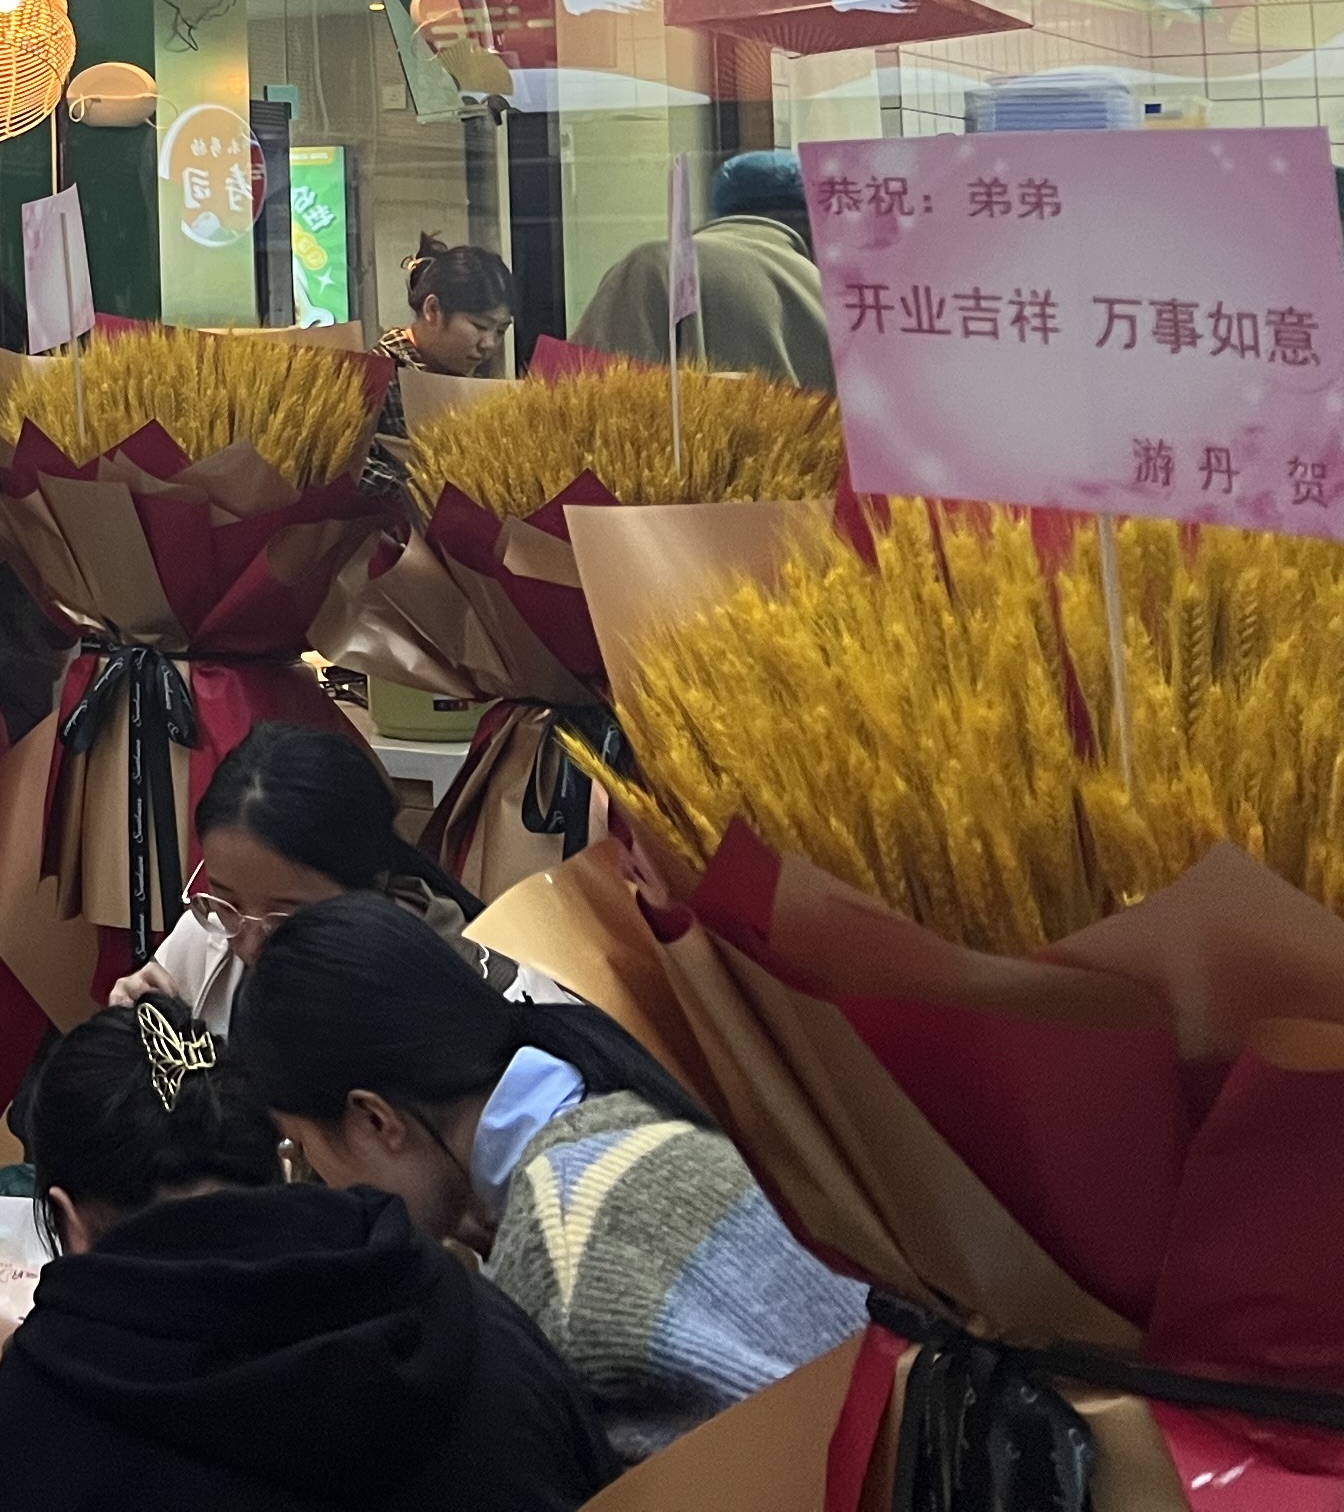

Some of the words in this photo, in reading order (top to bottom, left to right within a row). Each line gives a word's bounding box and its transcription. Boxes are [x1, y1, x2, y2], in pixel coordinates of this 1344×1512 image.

[845, 283, 1061, 346] 开业吉祥
[1092, 295, 1321, 368] 万事如意
